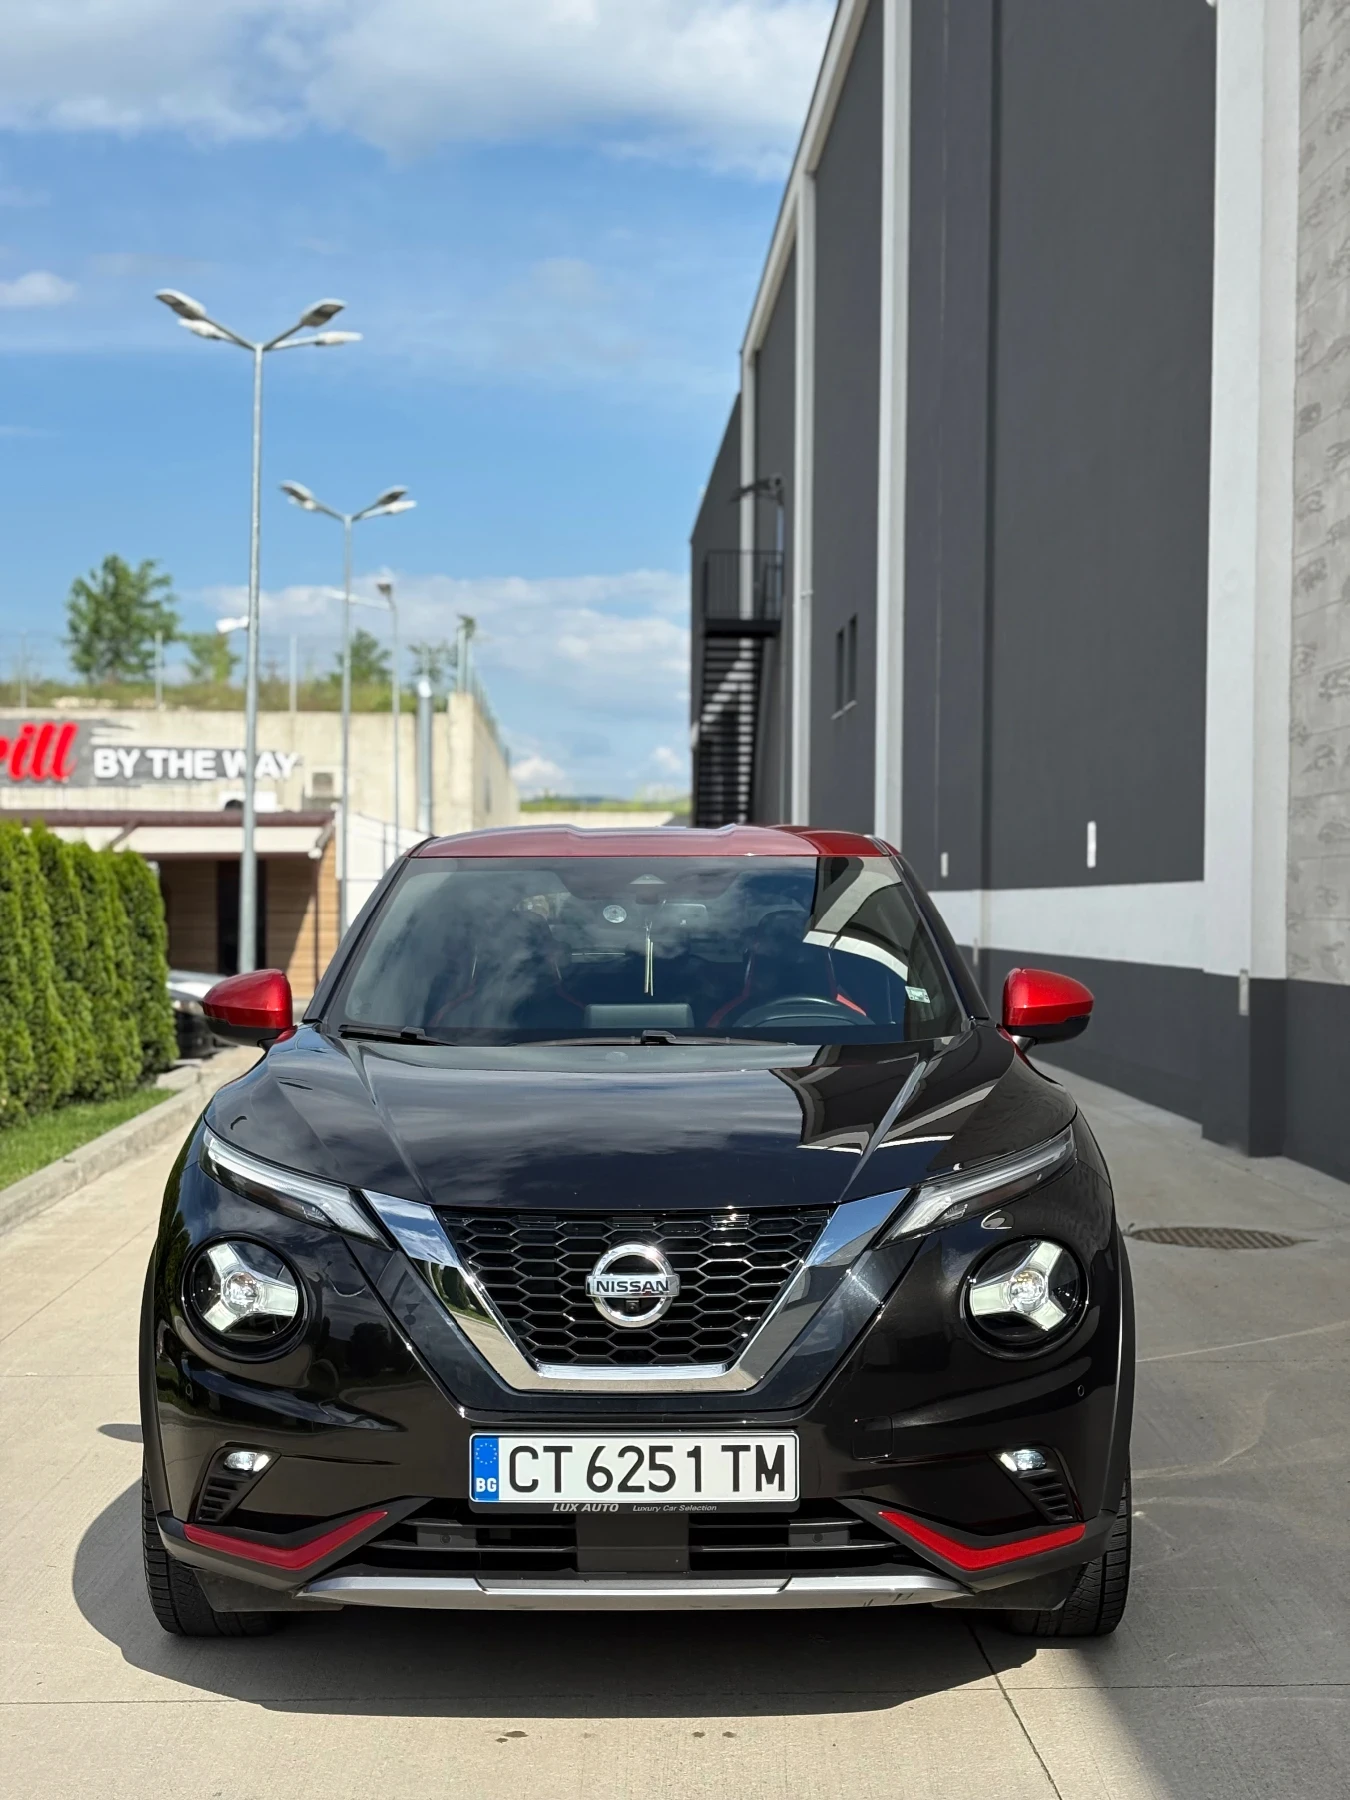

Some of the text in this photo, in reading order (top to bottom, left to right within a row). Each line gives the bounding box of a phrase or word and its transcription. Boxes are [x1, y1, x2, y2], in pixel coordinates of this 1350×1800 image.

[93, 748, 299, 780] BY THE WAY
[596, 1280, 669, 1293] NISSAN
[509, 1444, 785, 1493] CT 6251 TM
[475, 1477, 497, 1493] BG
[552, 1503, 619, 1512] LUX AUTO
[632, 1504, 717, 1512] Luxury Car Selection
